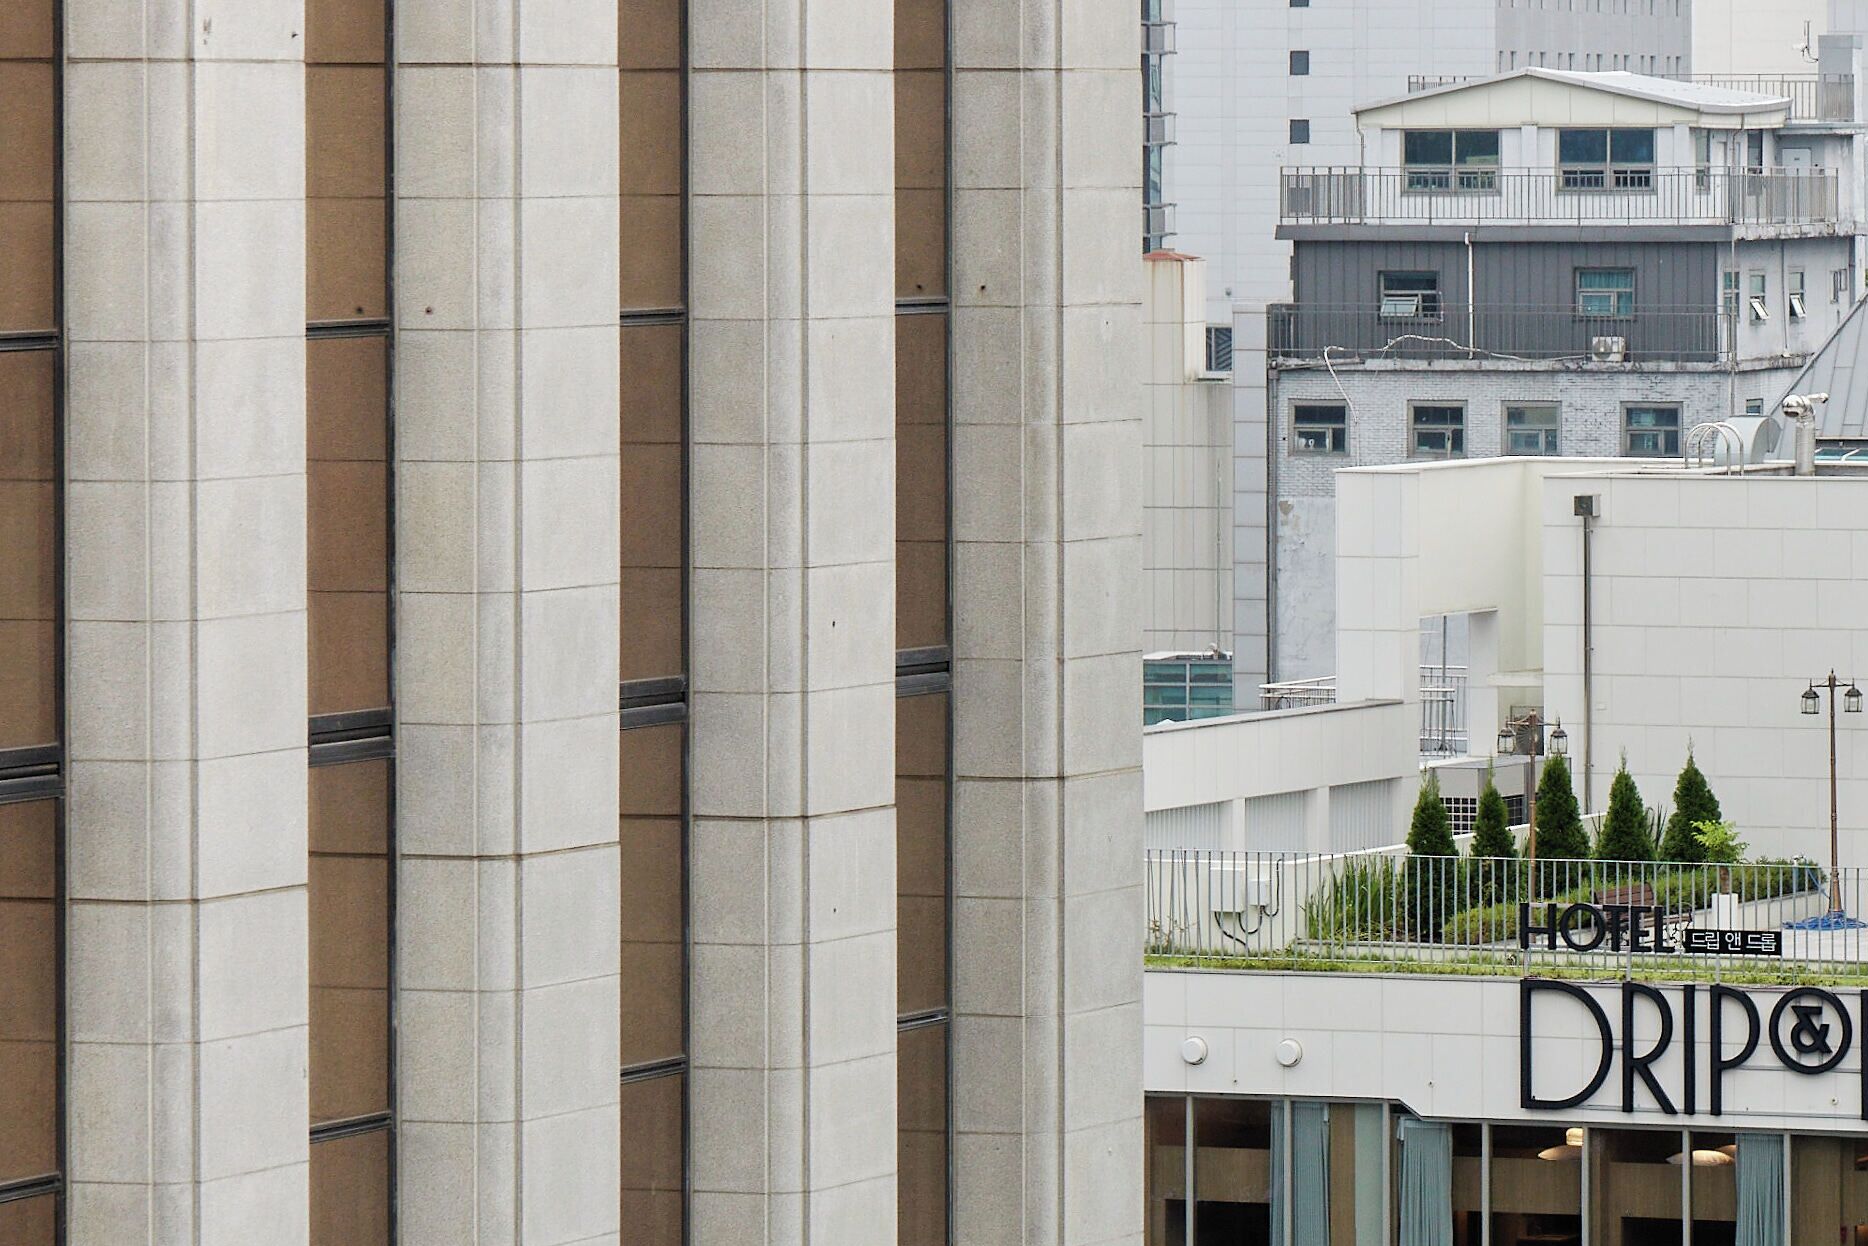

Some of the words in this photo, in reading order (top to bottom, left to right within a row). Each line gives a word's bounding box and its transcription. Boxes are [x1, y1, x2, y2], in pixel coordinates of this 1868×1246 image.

[1519, 902, 1676, 953] HOTEL
[1691, 931, 1720, 950] 드립
[1725, 931, 1742, 951] 앤
[1746, 934, 1776, 952] 드롭
[1520, 979, 1760, 1116] DRIP
